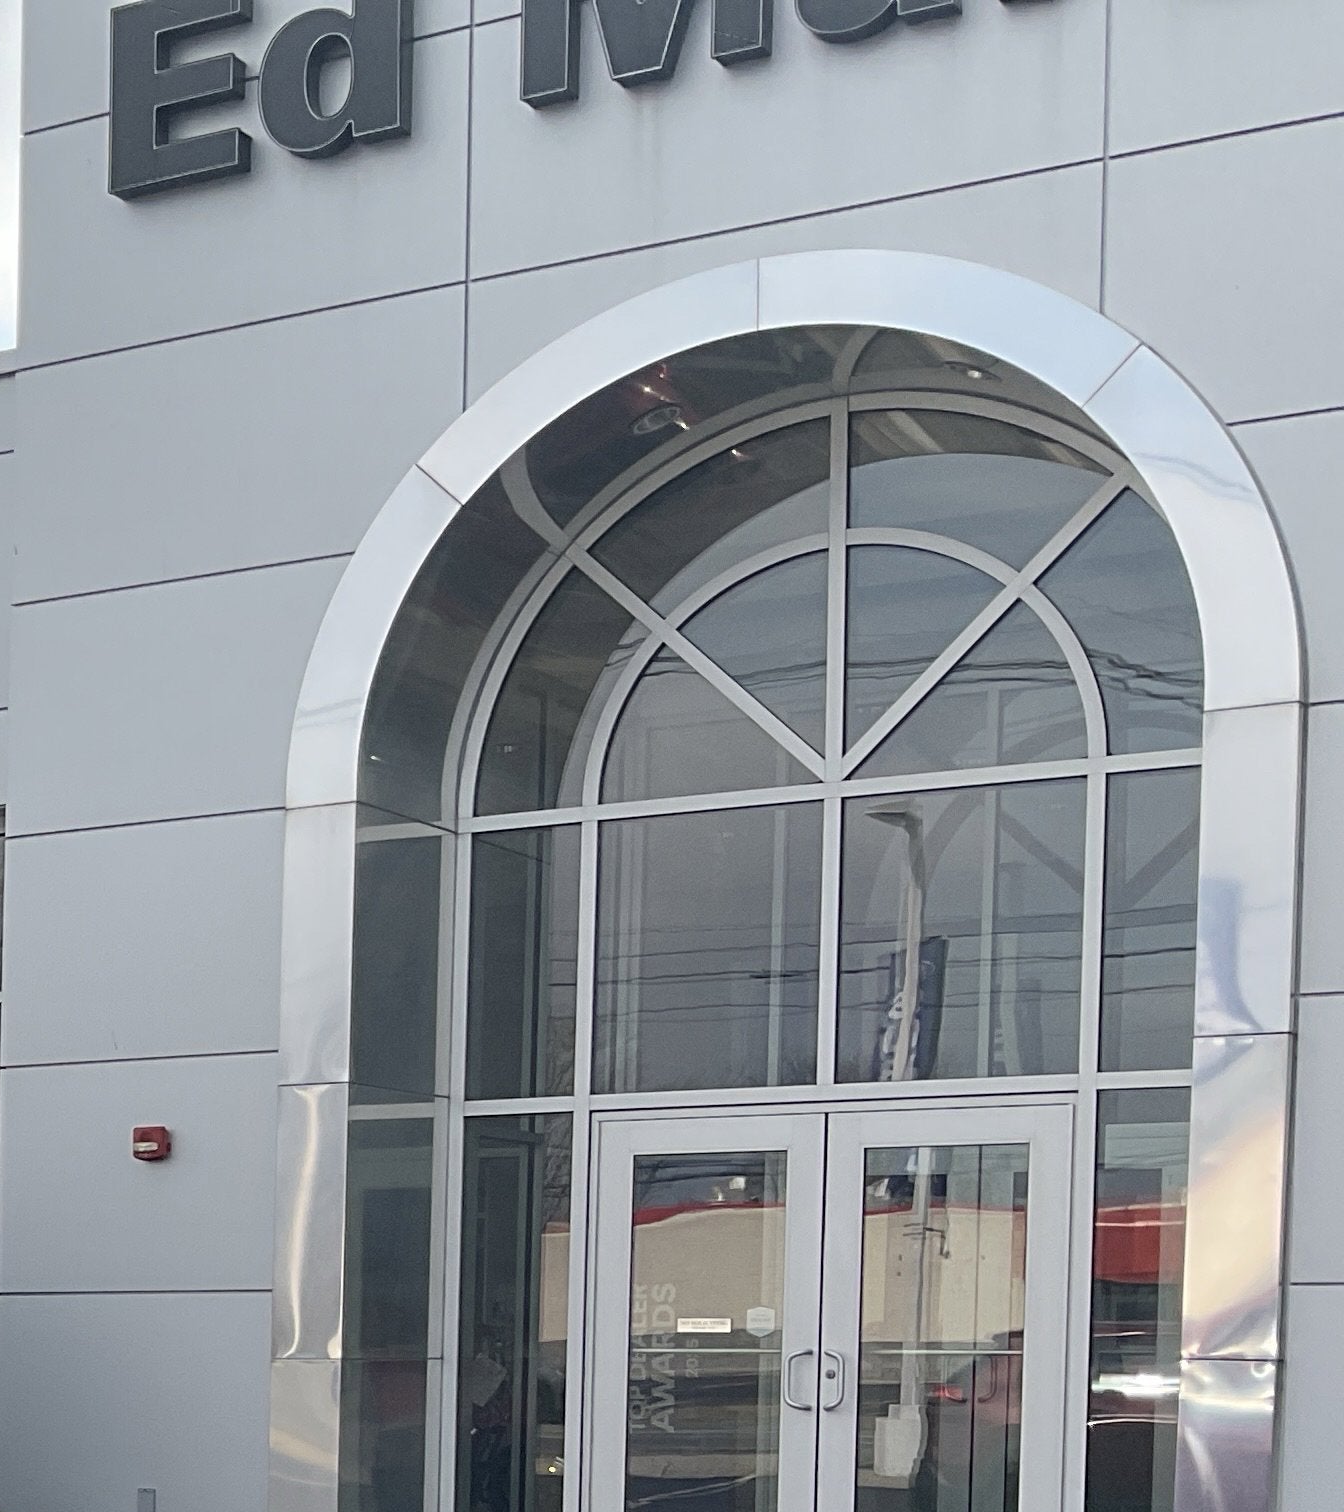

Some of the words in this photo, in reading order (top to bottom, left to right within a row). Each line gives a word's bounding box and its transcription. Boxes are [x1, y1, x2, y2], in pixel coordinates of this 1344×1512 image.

[108, 0, 412, 200] Ed
[629, 1386, 648, 1435] TOP
[650, 1283, 676, 1433] AWARDS
